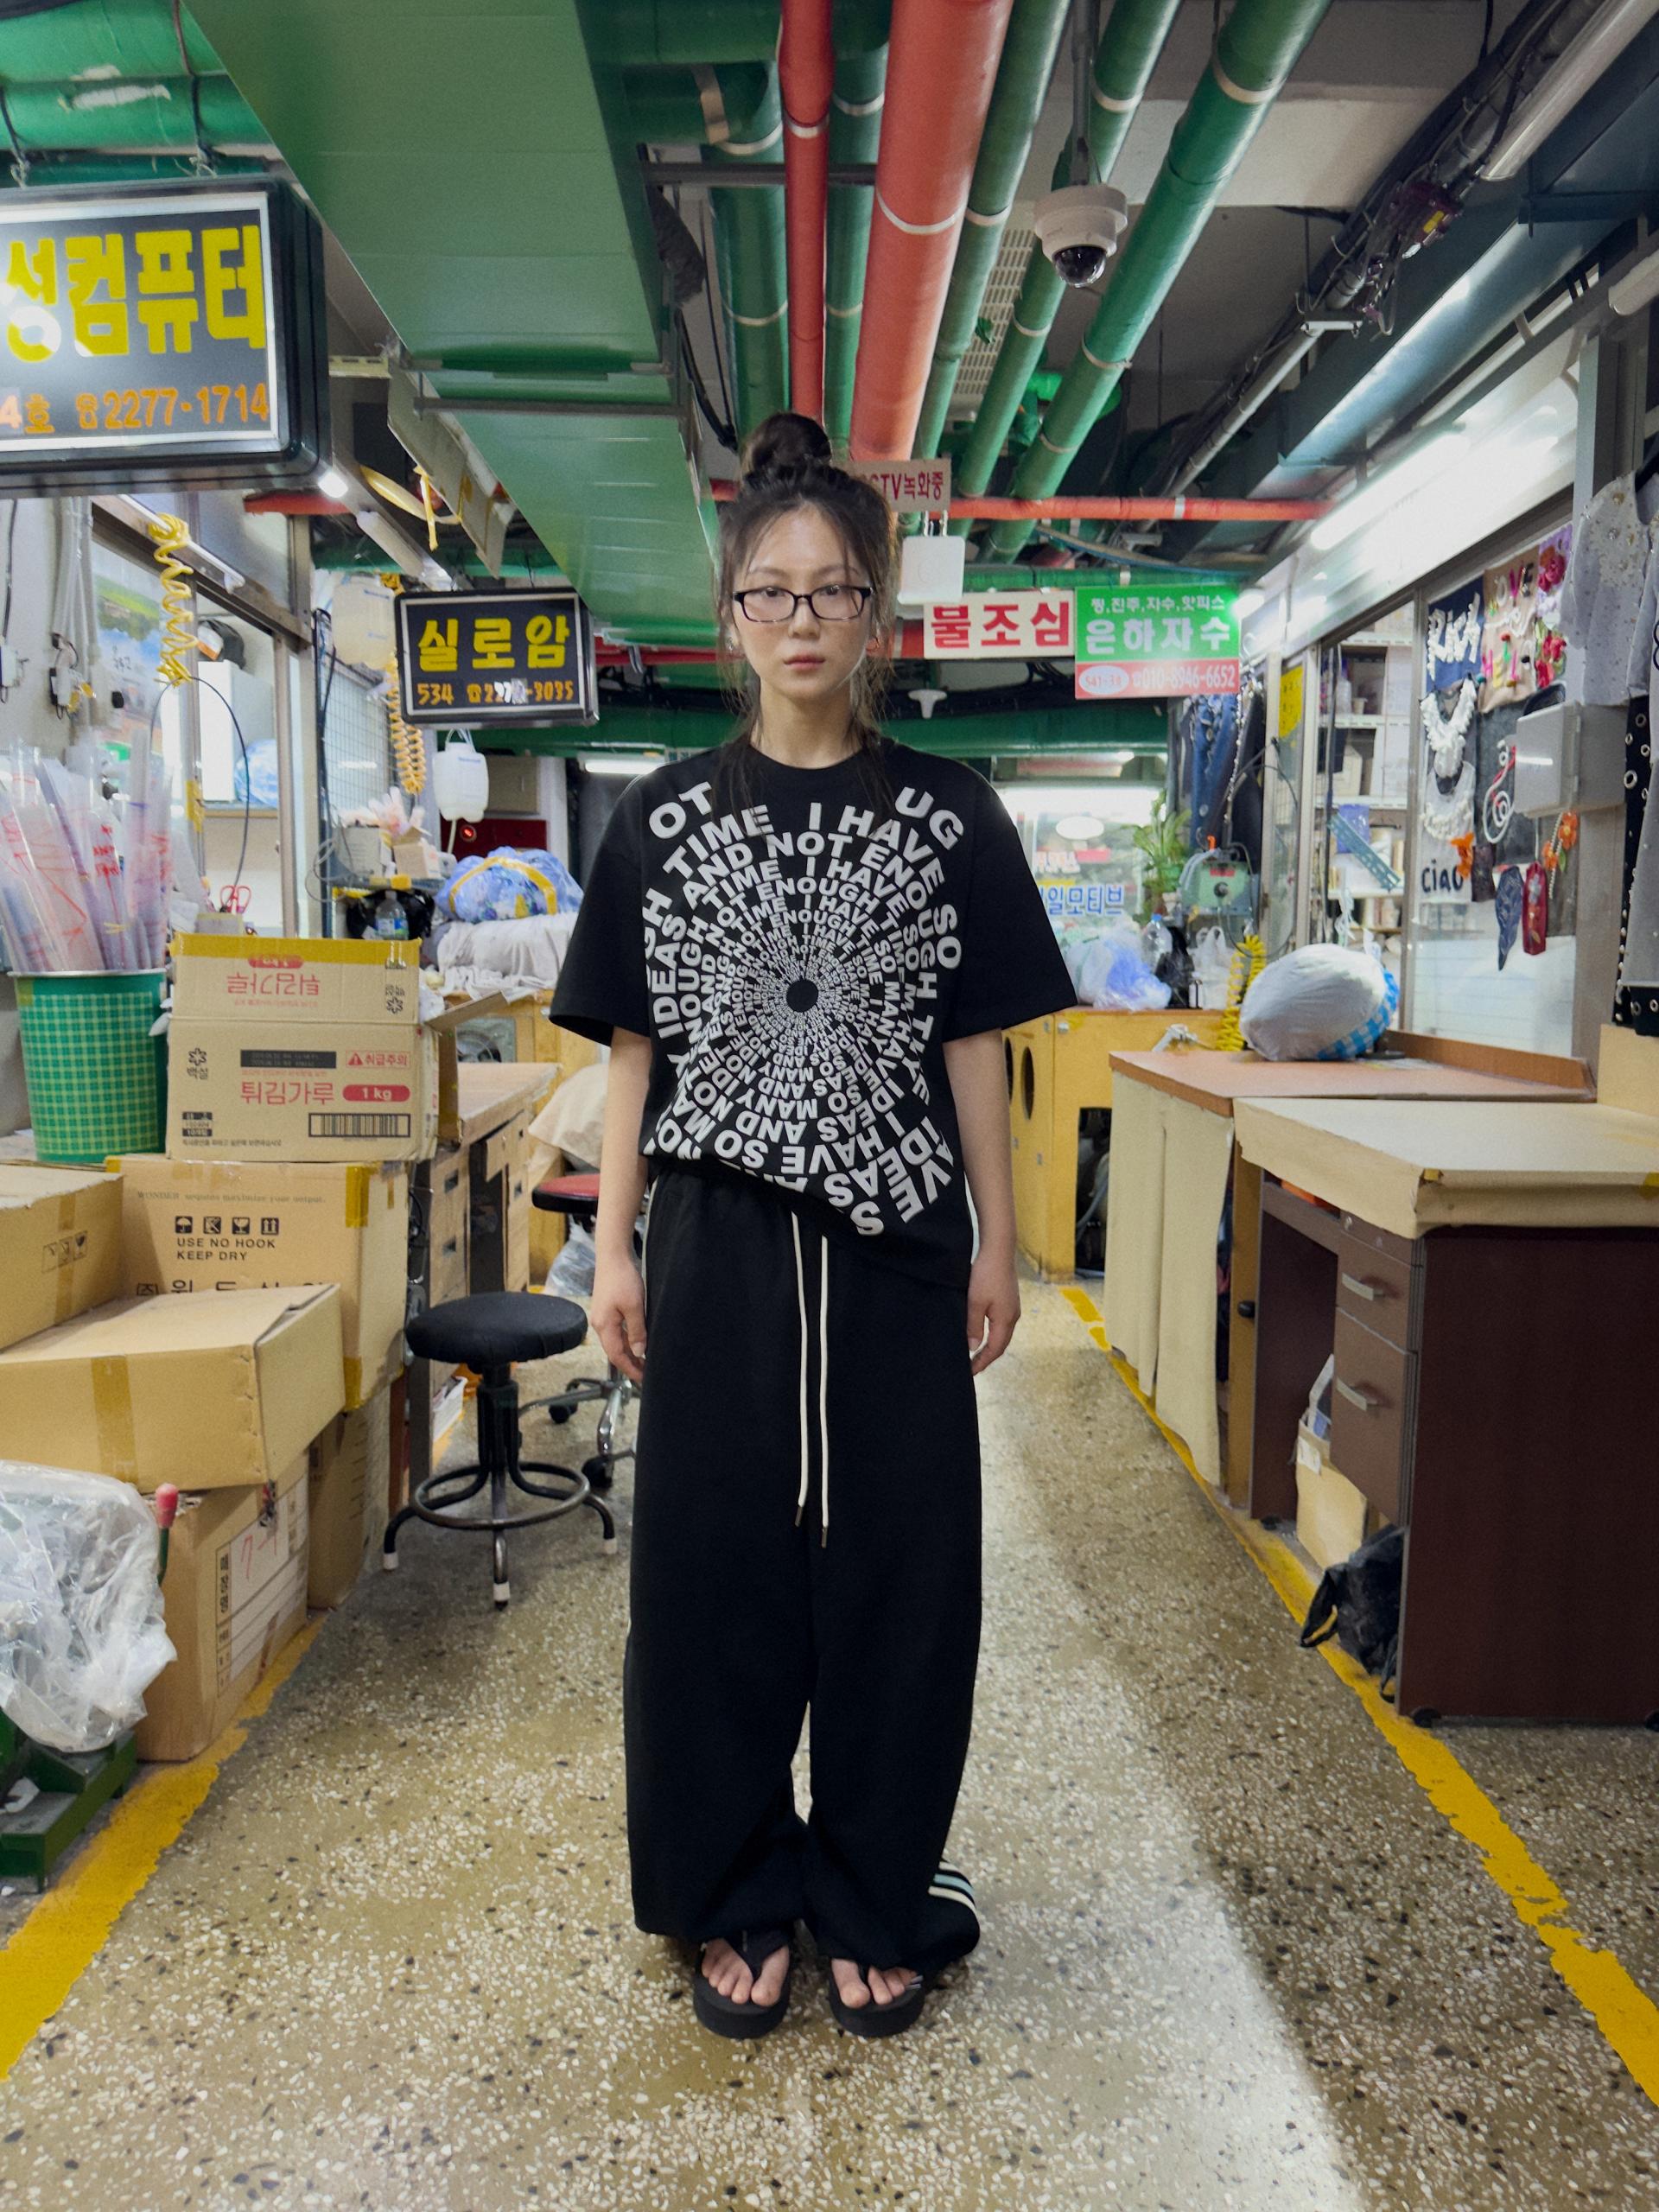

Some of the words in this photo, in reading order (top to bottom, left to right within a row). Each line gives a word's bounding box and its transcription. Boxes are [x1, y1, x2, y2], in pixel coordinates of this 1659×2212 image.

[418, 614, 570, 672] 실로암
[931, 601, 1070, 649] 불조심
[1086, 616, 1230, 655] 은하자수
[416, 683, 454, 706] 534
[809, 802, 822, 830] I
[662, 804, 774, 880] TIME
[766, 831, 853, 859] NOT
[837, 804, 944, 894] HAVE
[683, 842, 753, 910] AND
[701, 859, 783, 910] TIME
[806, 856, 816, 877] I
[755, 876, 880, 914] ENOUGH
[826, 858, 910, 918] HAVE
[1039, 884, 1123, 915] 일모티브
[704, 892, 748, 948] NOT
[729, 896, 788, 933] TIME
[768, 909, 857, 938] ENOUGH
[818, 894, 880, 939] HAVE
[859, 842, 938, 999] ENOUGH
[732, 920, 765, 960] NOT
[813, 924, 856, 955] HAVE
[874, 939, 897, 973] SO
[902, 924, 920, 971] SO
[933, 904, 962, 969] SO
[651, 913, 687, 1039] IDEAS
[855, 933, 883, 985] TIME
[227, 972, 321, 996] 튀김가루
[700, 953, 721, 1014] AND
[846, 1010, 880, 1061] HAVE
[871, 981, 900, 1053] MANY
[720, 1010, 760, 1066] IDEAS
[862, 1020, 912, 1092] HAVE
[714, 1045, 757, 1085] NOT
[758, 1061, 814, 1084] MANY
[812, 1050, 874, 1097] IDEAS
[819, 1055, 847, 1077] SO
[241, 1081, 335, 1105] 튀김가루
[734, 1088, 818, 1121] MANY
[758, 1077, 807, 1100] AND
[827, 1084, 861, 1114] SO
[735, 1110, 807, 1145] AND
[817, 1077, 905, 1142] IDEAS
[714, 1129, 769, 1168] SO
[780, 1125, 885, 1174] HAVE
[823, 1116, 940, 1207] IDEAS
[177, 1237, 204, 1248] USE
[210, 1237, 230, 1248] NO
[235, 1239, 276, 1249] HOOK
[177, 1250, 213, 1261] KEEP
[219, 1251, 248, 1262] DRY
